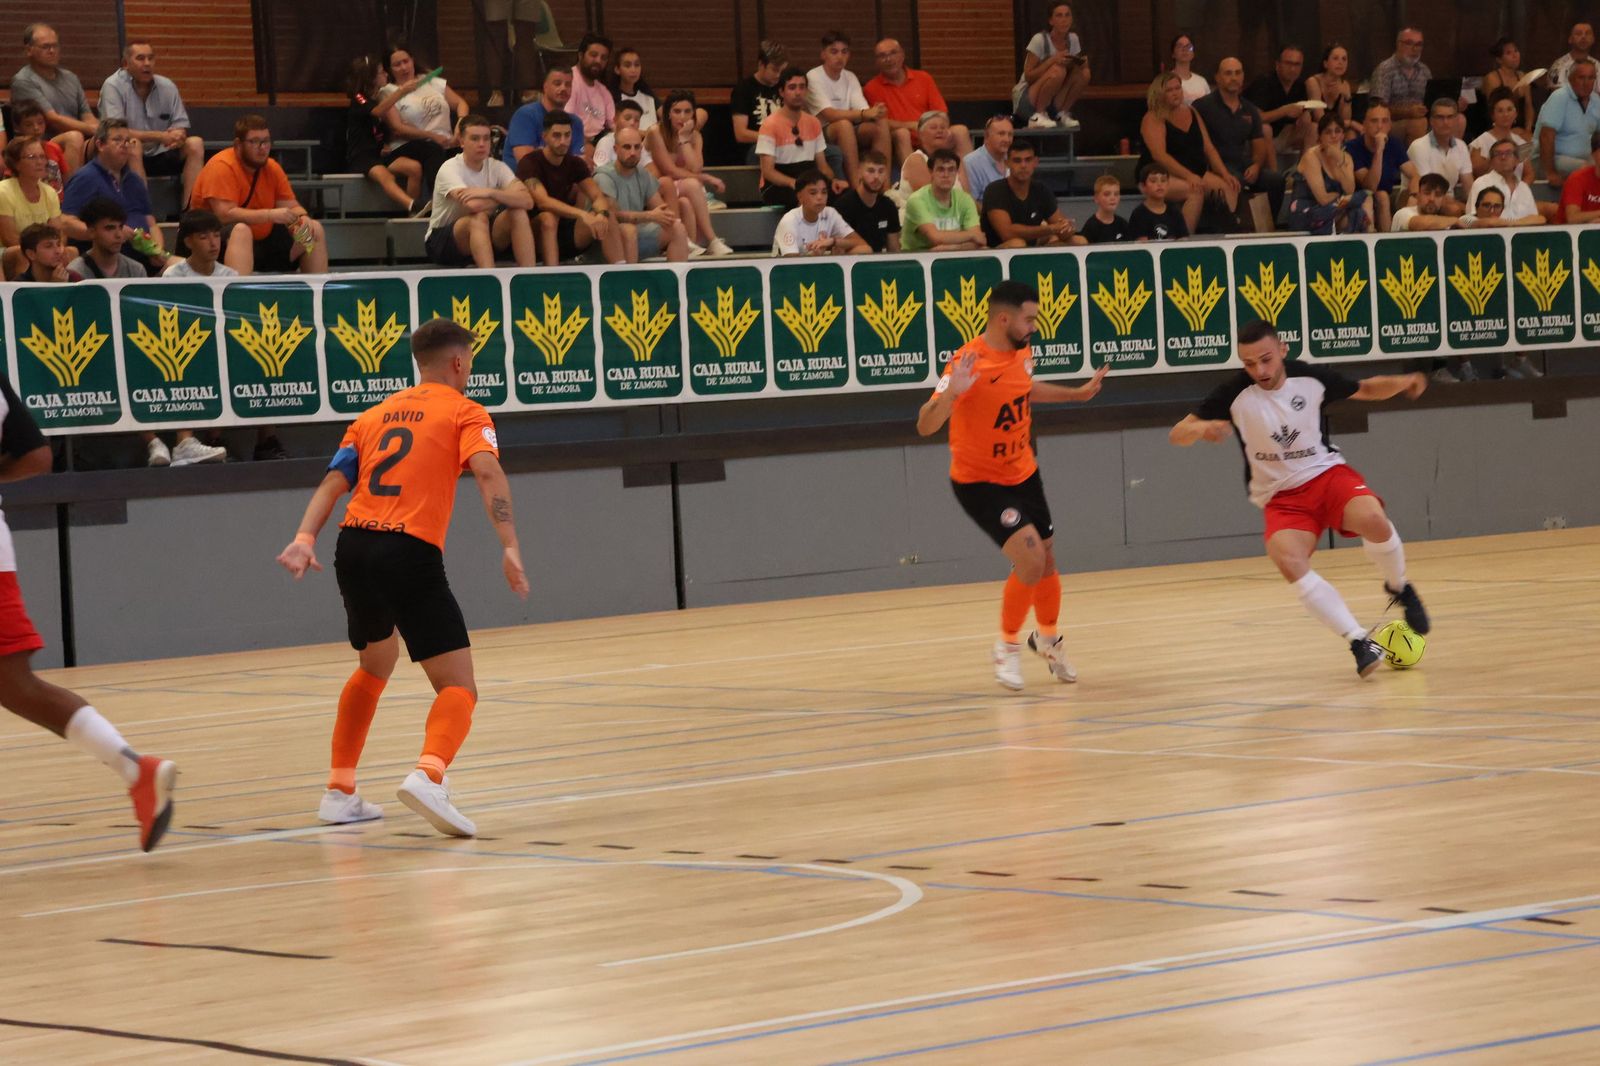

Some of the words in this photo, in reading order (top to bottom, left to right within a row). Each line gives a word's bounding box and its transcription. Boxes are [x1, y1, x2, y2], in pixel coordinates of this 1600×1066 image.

[1517, 318, 1541, 328] CAJA
[1542, 315, 1573, 326] RURAL
[1584, 313, 1600, 325] CAJ
[1381, 325, 1405, 336] CAJA
[1407, 323, 1439, 334] RURAL
[1450, 322, 1473, 332] CAJA
[1475, 319, 1506, 330] RURAL
[1278, 330, 1300, 342] RAL
[1312, 329, 1335, 340] CAJA
[1338, 327, 1370, 338] RURAL
[1470, 332, 1496, 340] ZAMORA
[1093, 341, 1118, 352] CAJA
[1121, 339, 1155, 350] RURAL
[1167, 337, 1191, 348] CAJA
[1193, 335, 1229, 347] RURAL
[1322, 341, 1331, 349] DE
[1332, 340, 1360, 348] ZAMORA
[1402, 336, 1429, 344] ZAMORA
[939, 351, 956, 362] CA
[1032, 346, 1044, 357] JA
[1045, 344, 1081, 357] RURAL
[1178, 350, 1187, 358] DE
[1189, 349, 1218, 357] ZAMORA
[859, 354, 886, 368] CAJA
[889, 352, 926, 366] RURAL
[1040, 358, 1070, 366] ZAMORA
[1104, 353, 1114, 361] DE
[1115, 353, 1145, 361] ZAMORA
[693, 364, 722, 377] CAJA
[725, 361, 763, 374] RURAL
[777, 359, 805, 372] CAJA
[808, 357, 845, 370] RURAL
[519, 371, 548, 386] CAJA
[552, 369, 592, 384] RURAL
[608, 368, 636, 381] CAJA
[639, 366, 679, 379] RURAL
[790, 372, 801, 381] DE
[803, 371, 834, 380] ZAMORA
[871, 368, 882, 376] DE
[884, 367, 915, 376] ZAMORA
[332, 380, 364, 393] CAJA
[367, 378, 412, 391] RURAL
[621, 382, 632, 390] DE
[634, 380, 668, 389] ZAMORA
[706, 376, 718, 385] DE
[719, 375, 752, 384] ZAMORA
[132, 388, 169, 402] CAJA
[172, 386, 218, 400] RURAL
[234, 384, 268, 398] CAJA
[270, 382, 316, 396] RURAL
[464, 388, 491, 397] MORA
[532, 386, 544, 394] DE
[546, 384, 581, 393] ZAMORA
[26, 393, 63, 409] CAJA
[67, 391, 117, 406] RURAL
[250, 398, 263, 408] DE
[264, 397, 303, 407] ZAMORA
[346, 394, 359, 403] DE
[362, 393, 391, 402] ZAMO
[44, 408, 59, 419] DE
[61, 406, 103, 418] ZAMORA
[149, 403, 163, 413] DE
[165, 401, 205, 412] ZAMORA
[383, 411, 424, 422] DAVID
[368, 427, 413, 496] 2
